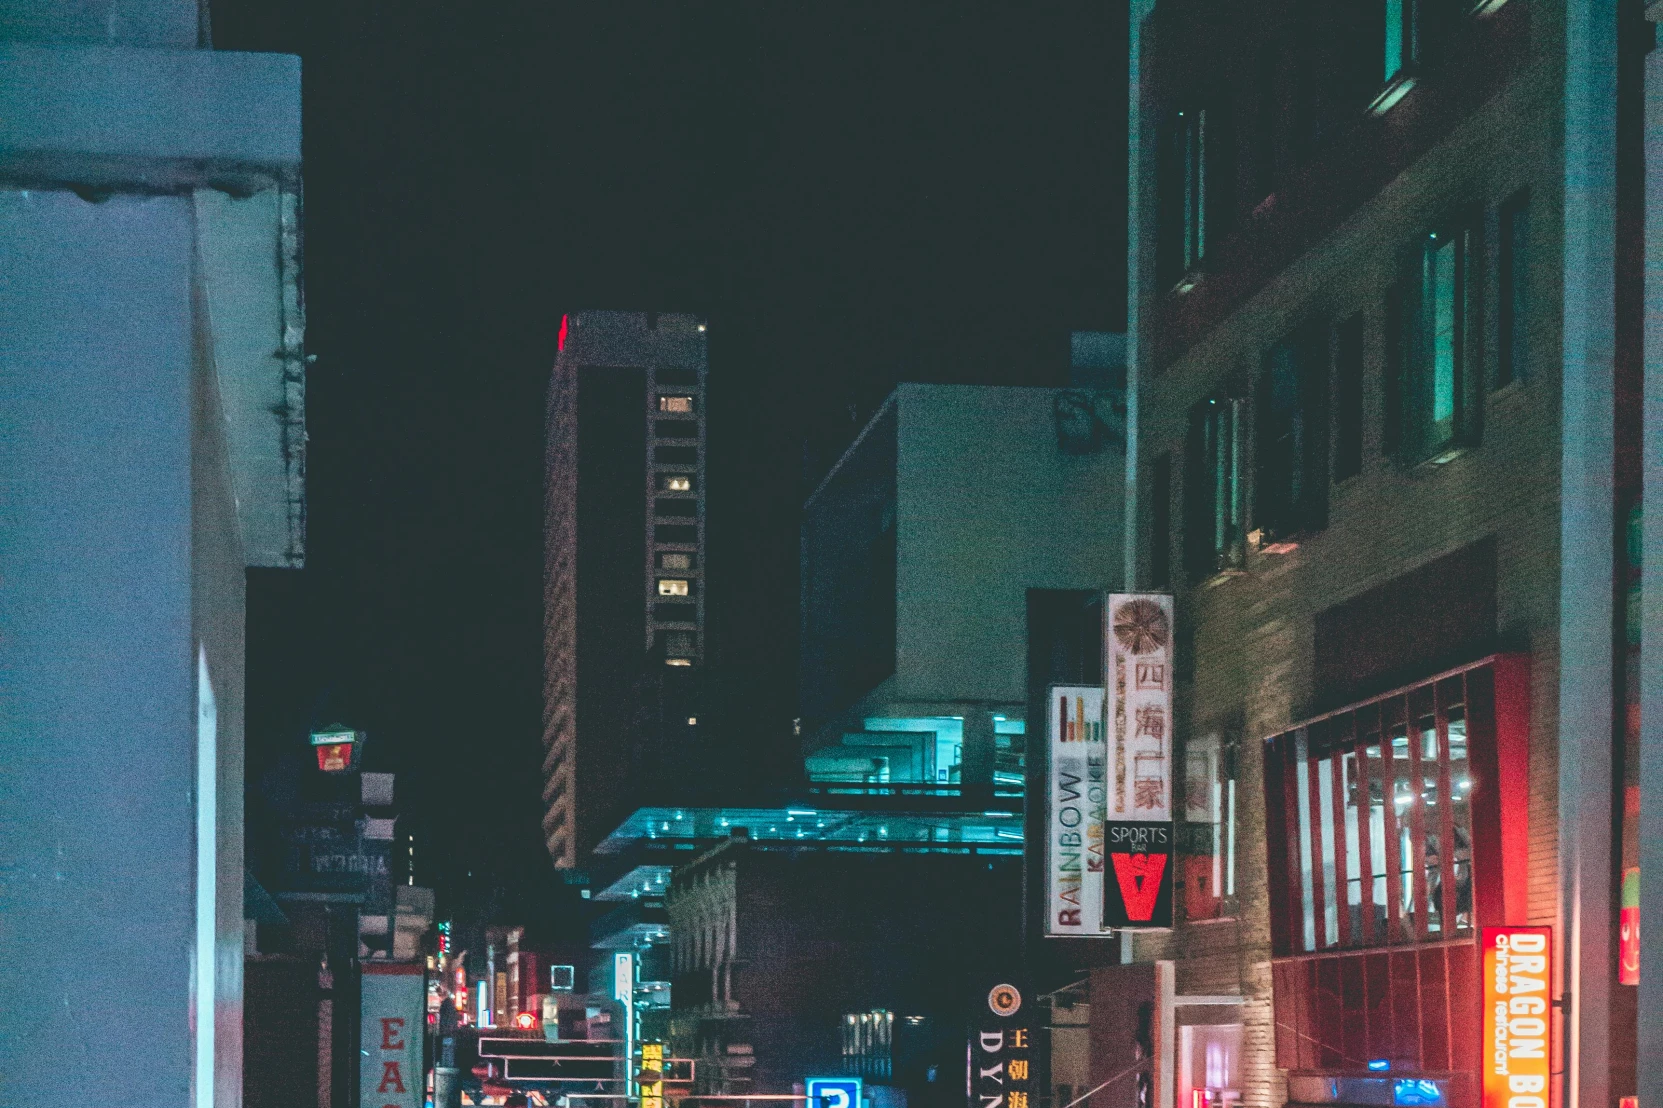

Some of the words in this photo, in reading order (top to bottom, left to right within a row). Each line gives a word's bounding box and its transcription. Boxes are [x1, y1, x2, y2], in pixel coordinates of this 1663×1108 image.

[1058, 772, 1082, 926] RAINBOW
[1111, 827, 1168, 843] SPORTS
[1495, 933, 1510, 994] chinese
[1509, 933, 1545, 1059] DRAGON
[1494, 1000, 1510, 1076] restaurant
